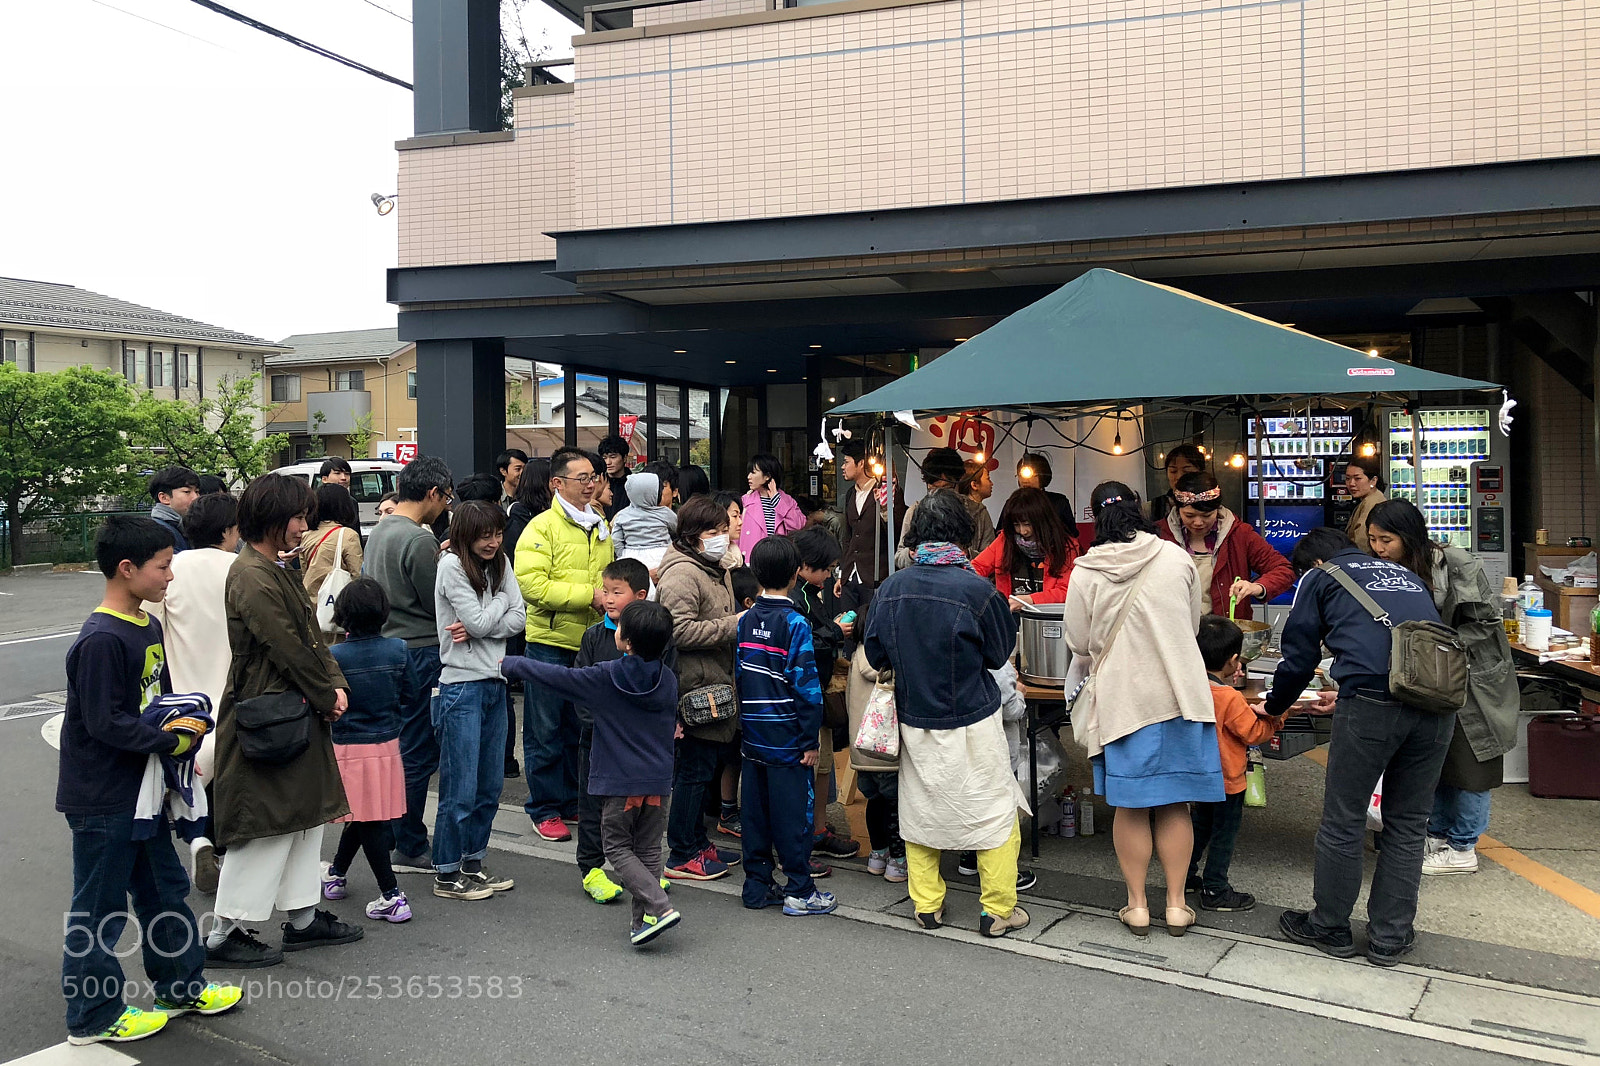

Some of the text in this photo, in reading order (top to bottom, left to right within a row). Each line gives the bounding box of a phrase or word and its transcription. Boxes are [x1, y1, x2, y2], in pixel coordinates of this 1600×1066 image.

[1264, 529, 1312, 538] アップグレー
